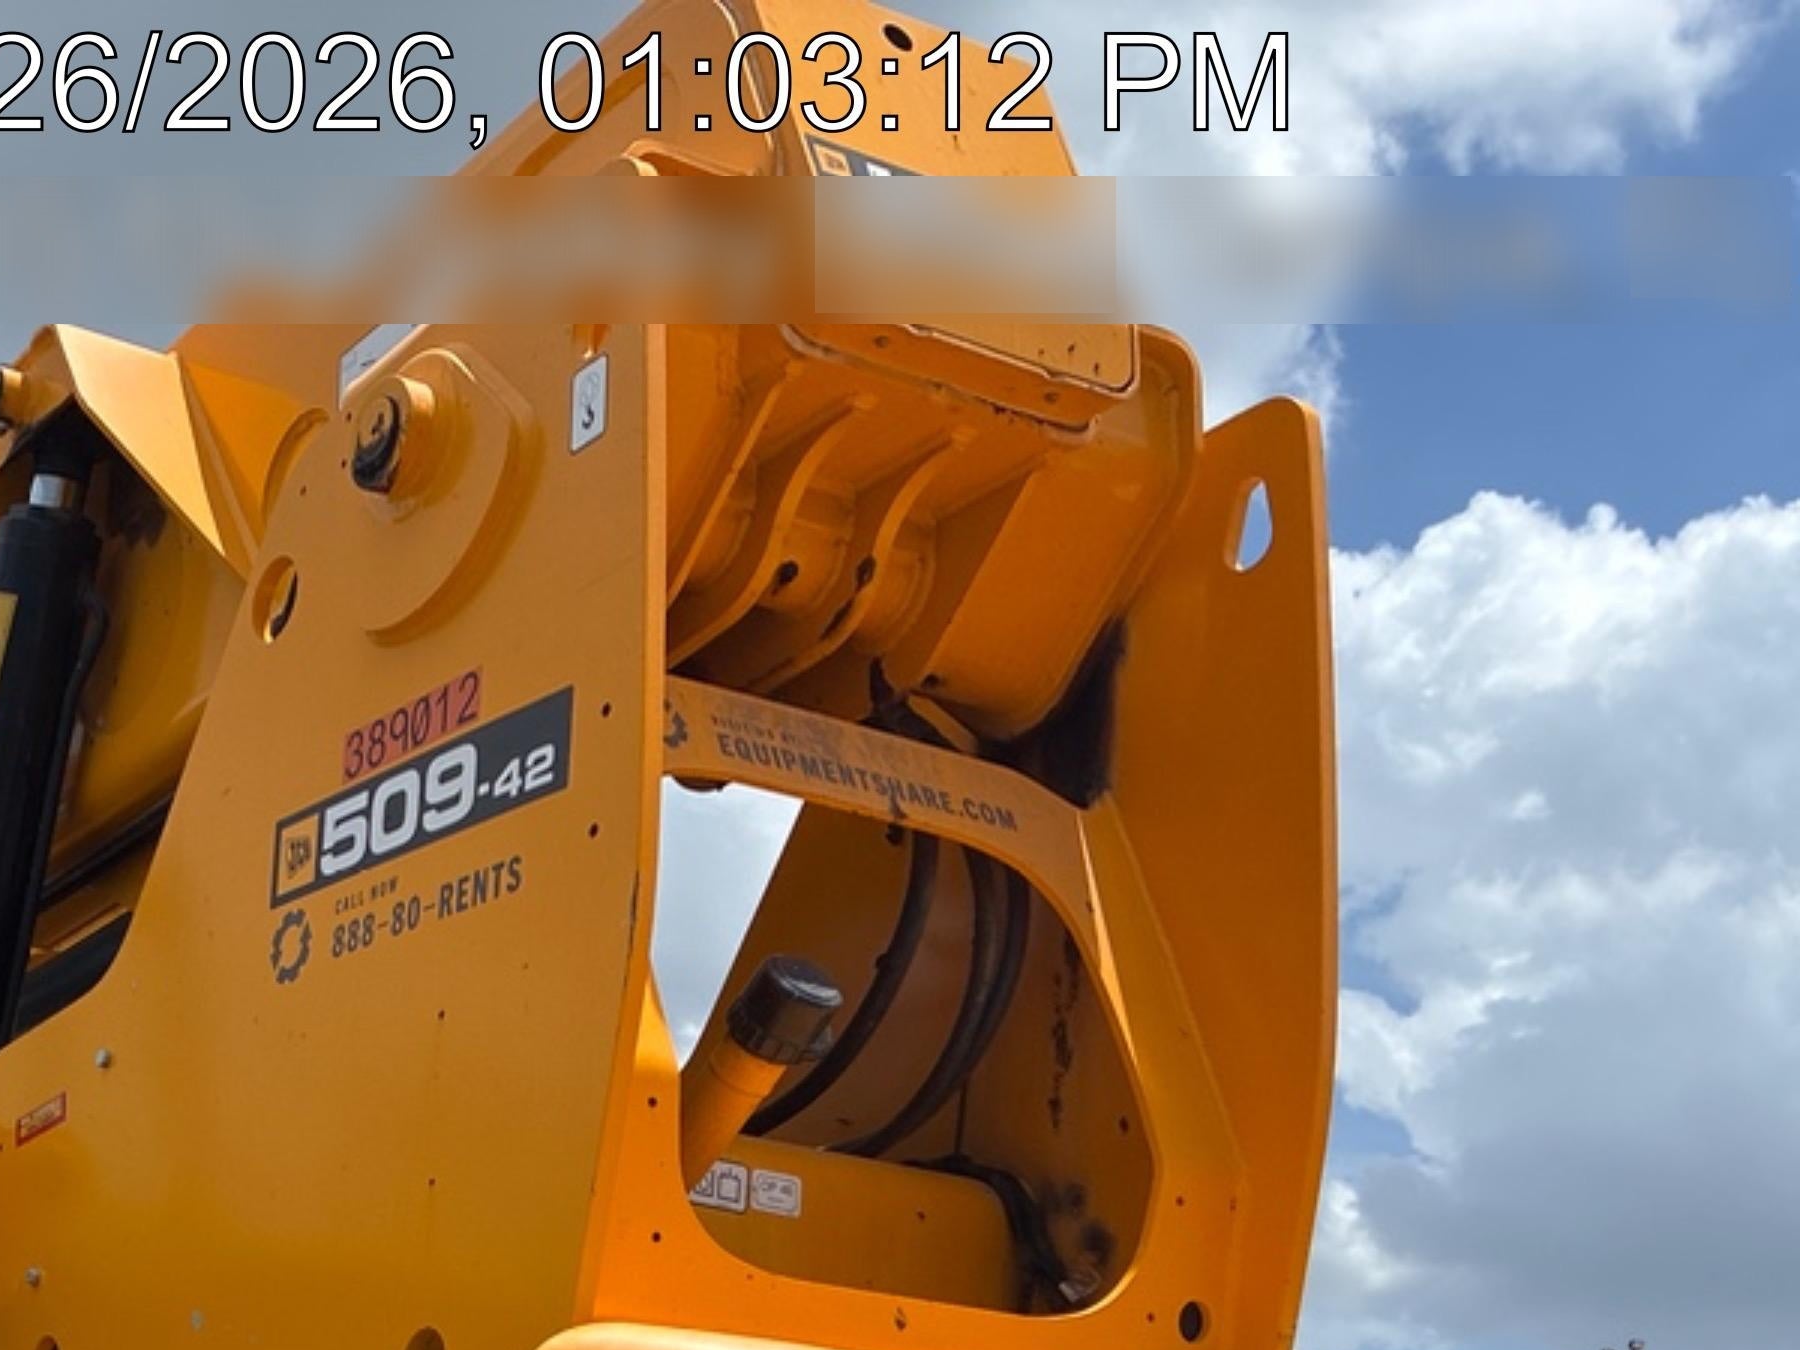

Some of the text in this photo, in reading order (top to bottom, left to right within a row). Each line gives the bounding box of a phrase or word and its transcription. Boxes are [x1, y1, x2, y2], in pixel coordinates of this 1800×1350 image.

[343, 670, 481, 779] 389012
[717, 732, 1019, 832] EQUIPMENTSHARE.COM
[331, 854, 524, 959] 888-80-RENTS
